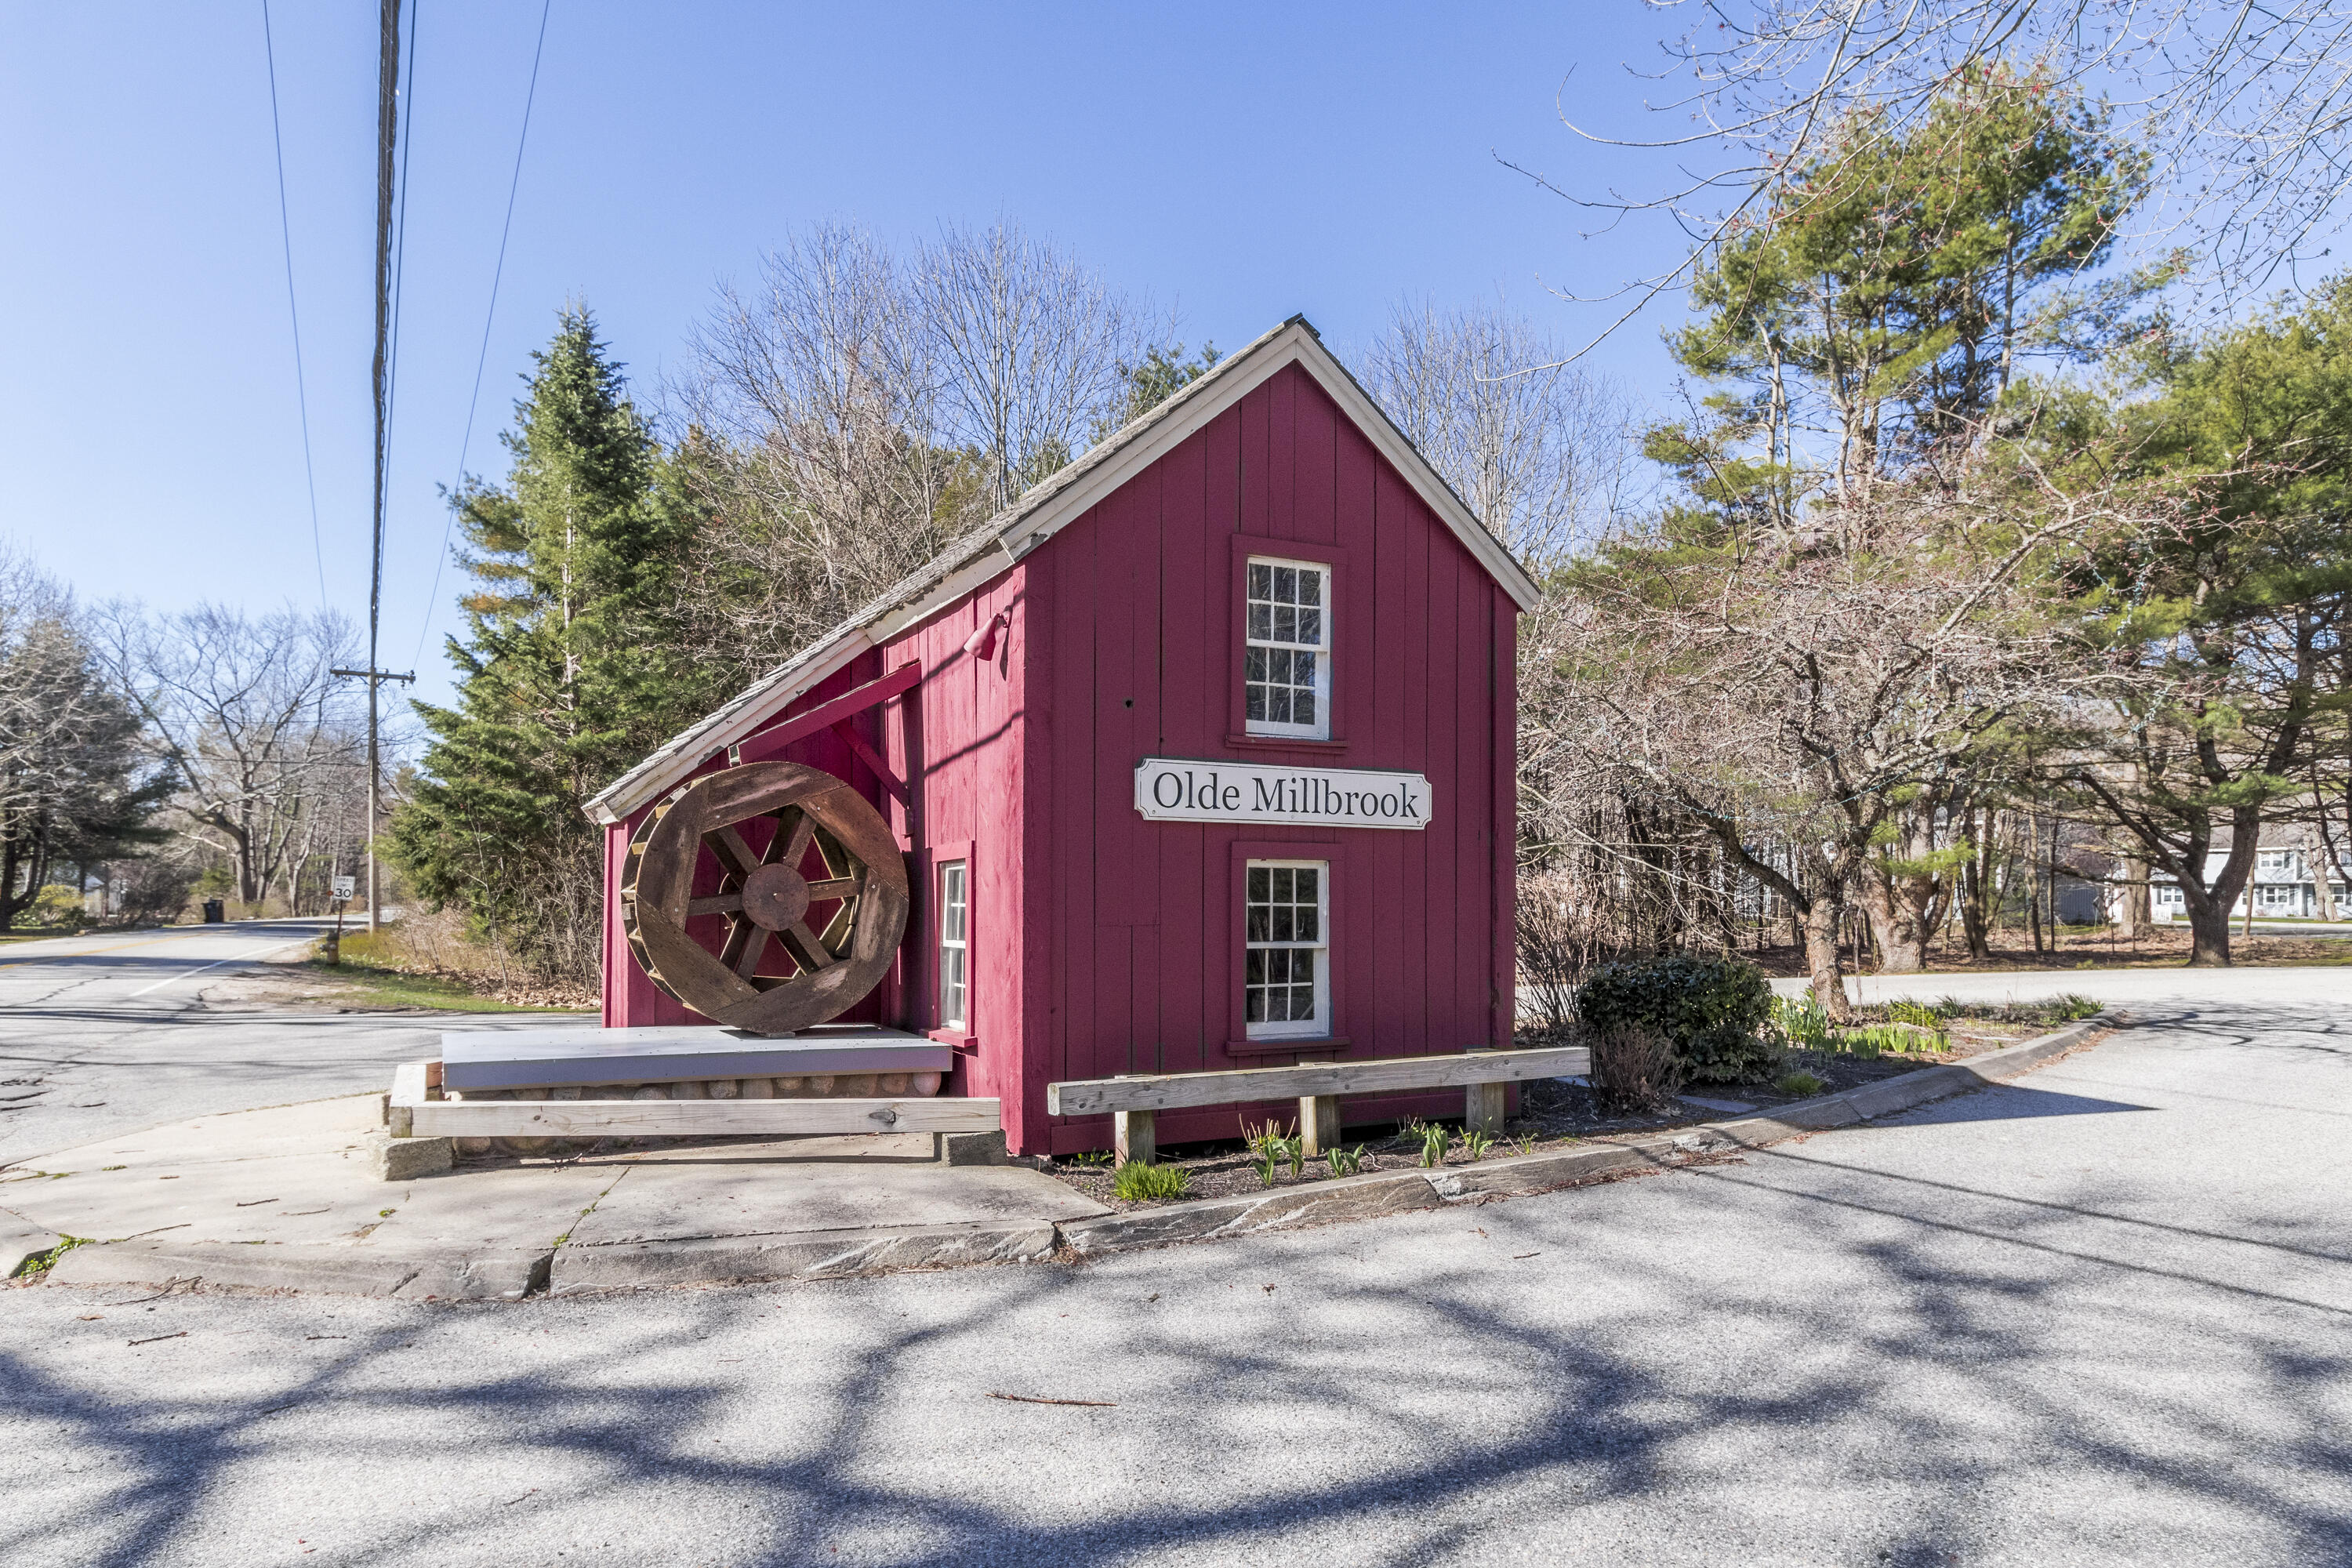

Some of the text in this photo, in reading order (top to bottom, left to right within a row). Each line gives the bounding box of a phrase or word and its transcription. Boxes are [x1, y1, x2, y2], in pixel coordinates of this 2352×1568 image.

[1153, 771, 1419, 818] Olde Millbrook
[335, 888, 351, 898] 30
